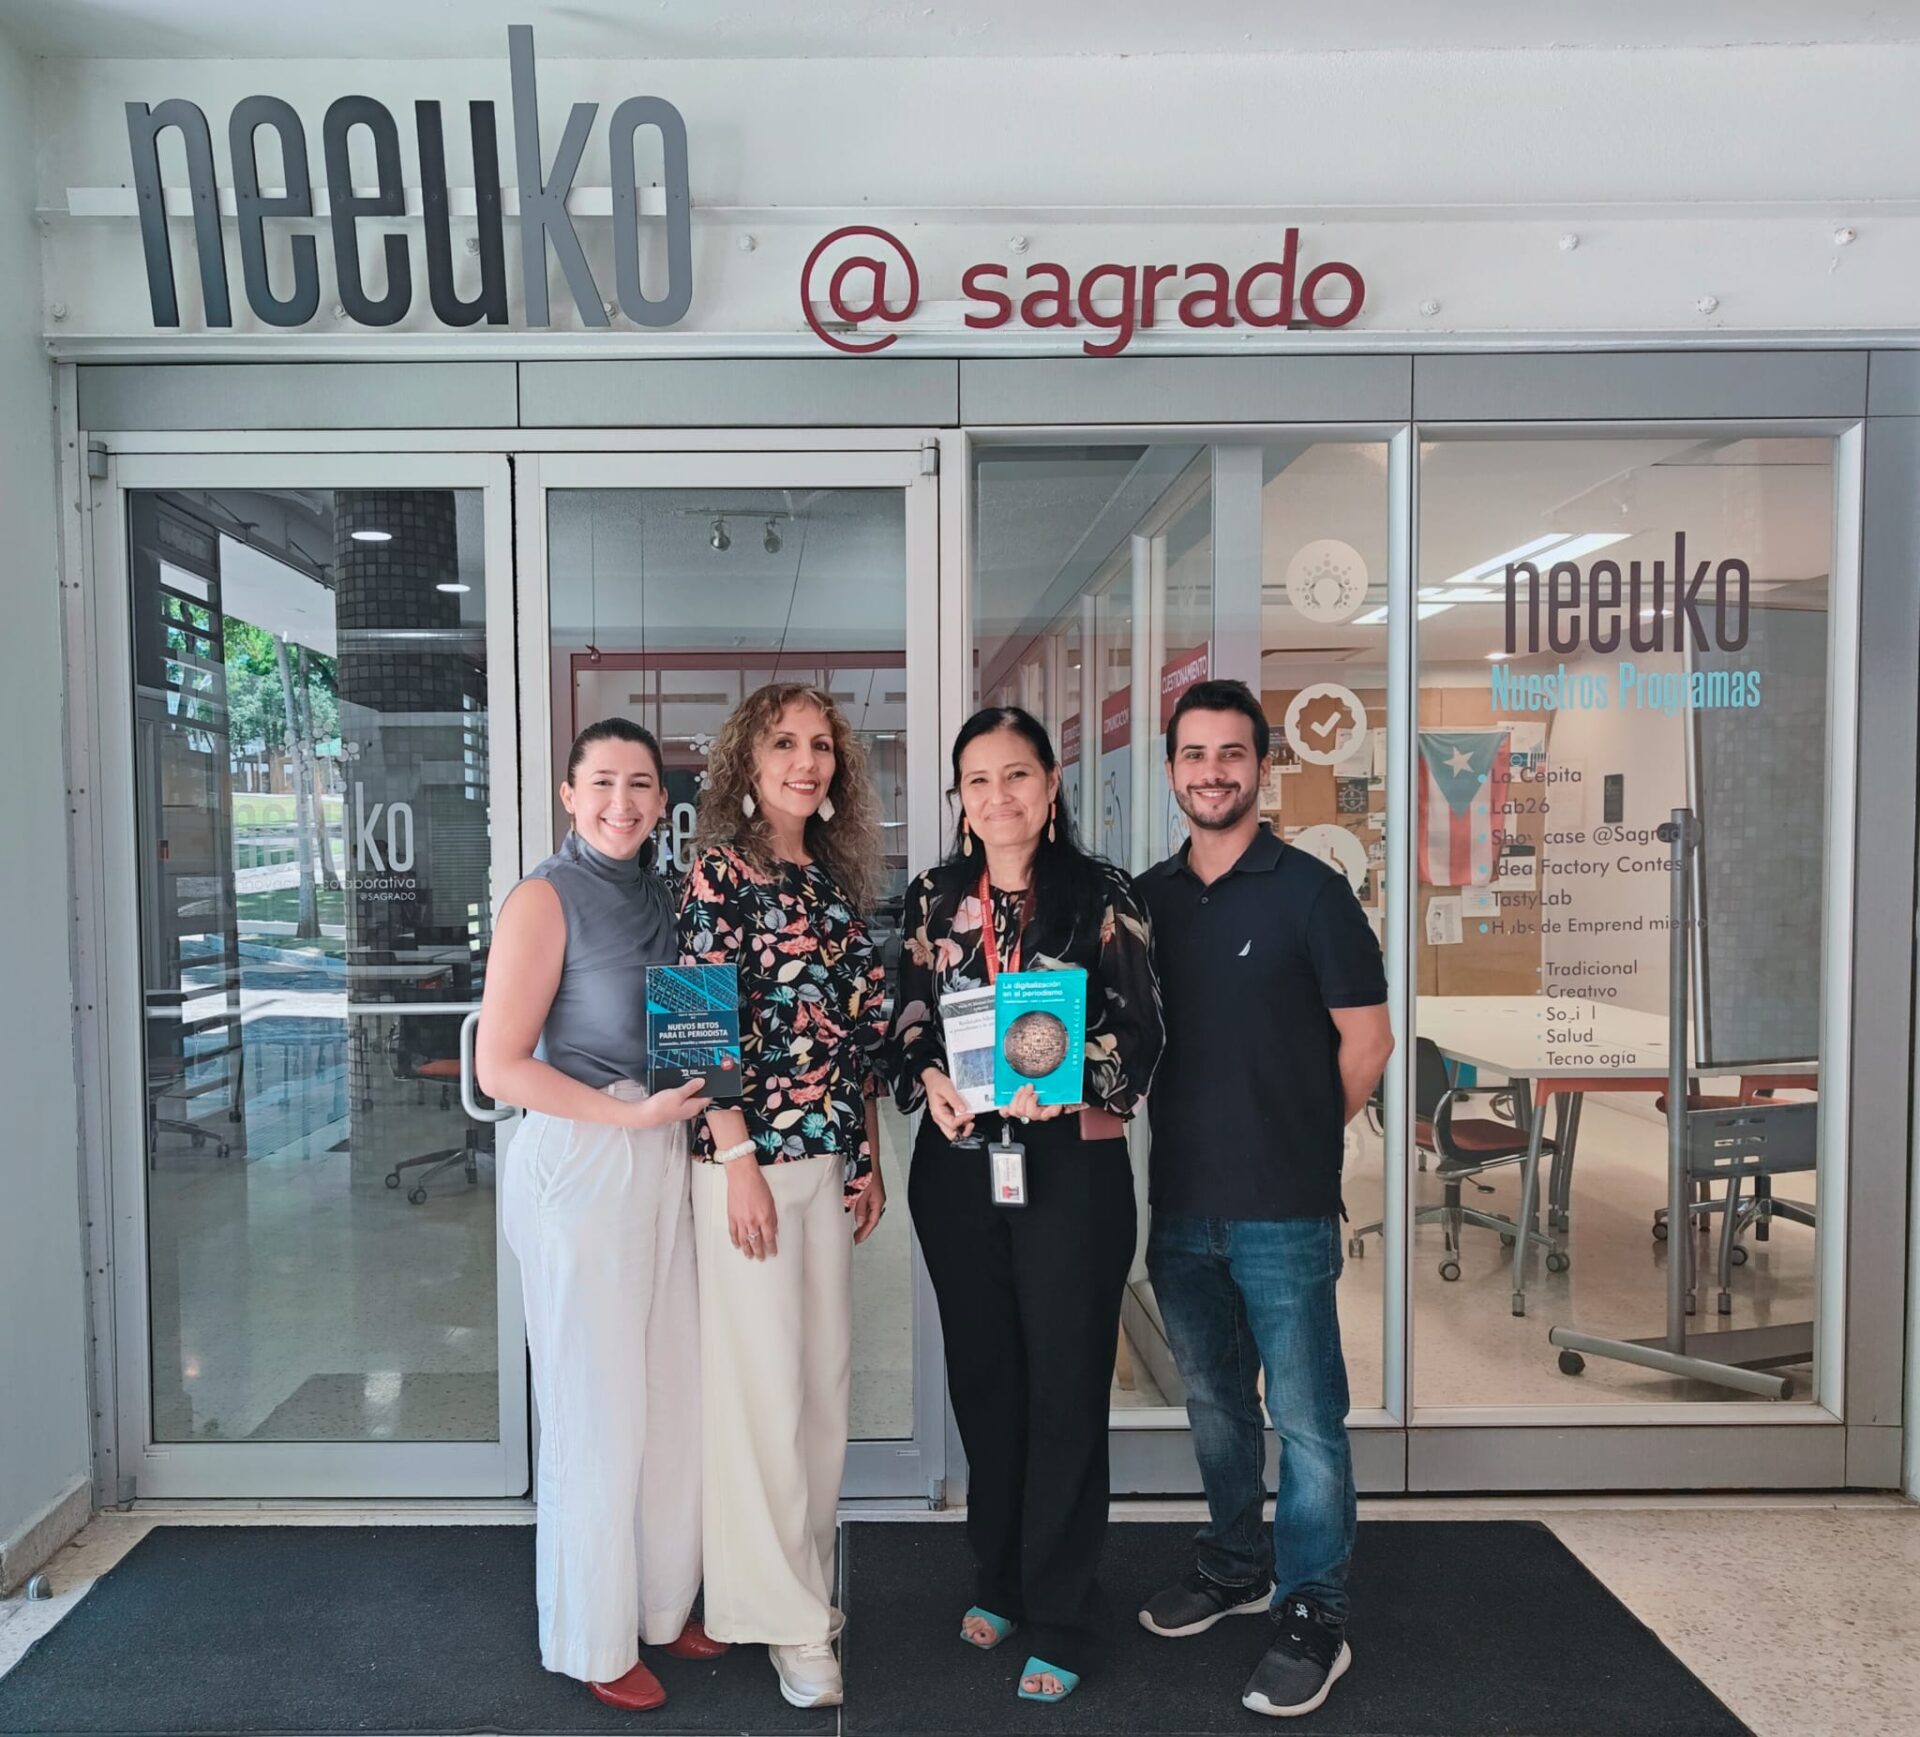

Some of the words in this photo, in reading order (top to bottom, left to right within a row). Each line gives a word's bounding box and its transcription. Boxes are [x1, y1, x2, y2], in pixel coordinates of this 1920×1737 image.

[125, 24, 694, 329] neeuko
[800, 225, 919, 353] @
[961, 227, 1366, 357] sagrado
[1503, 531, 1750, 655] neeuko
[1490, 663, 1609, 712] Nuestros
[1618, 661, 1761, 719] Programas
[1520, 767, 1582, 787] Cepita
[1491, 798, 1551, 815] Lab26
[231, 781, 415, 873] neuko
[1491, 829, 1586, 846] Shocase
[1541, 858, 1611, 878] Factory
[1616, 856, 1687, 873] Contes
[360, 891, 416, 902] @SAGRADO
[1491, 888, 1573, 909] TastyLab
[1541, 918, 1561, 934] de
[1546, 959, 1639, 977] Tradicional
[1546, 984, 1617, 999] Creativo
[1546, 1004, 1596, 1022] Soil
[659, 1031, 678, 1039] PARA
[678, 1031, 687, 1039] EL
[687, 1029, 728, 1038] PERIODISTA
[667, 1022, 696, 1031] NUEVOS
[1546, 1027, 1594, 1043] Salud
[1546, 1049, 1637, 1068] Tecnoogía
